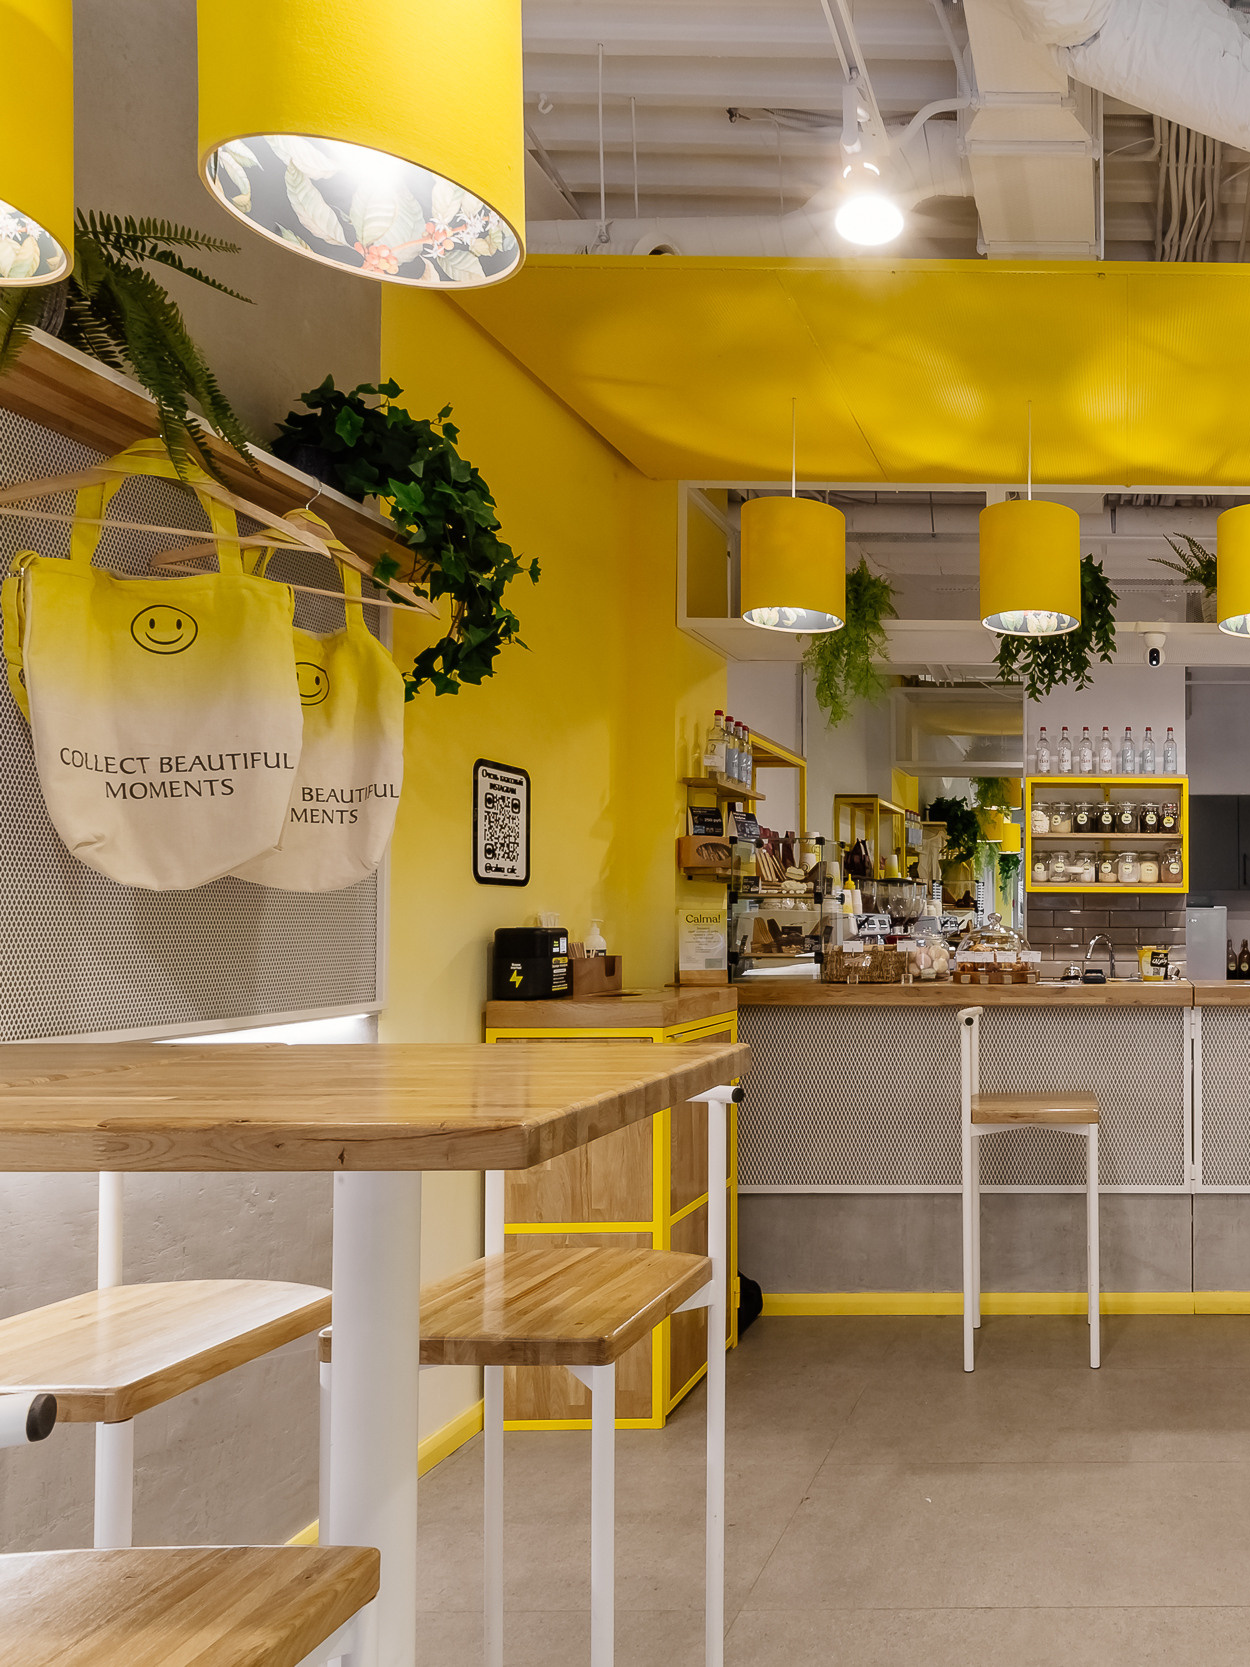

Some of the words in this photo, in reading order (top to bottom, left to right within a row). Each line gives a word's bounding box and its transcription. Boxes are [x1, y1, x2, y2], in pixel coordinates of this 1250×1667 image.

[60, 747, 150, 775] COLLECT
[159, 751, 294, 773] BEAUTIFUL
[105, 778, 234, 800] MOMENTS
[302, 783, 400, 804] BEAUTIFUL
[290, 807, 358, 825] MENTS
[685, 914, 721, 923] Calma!
